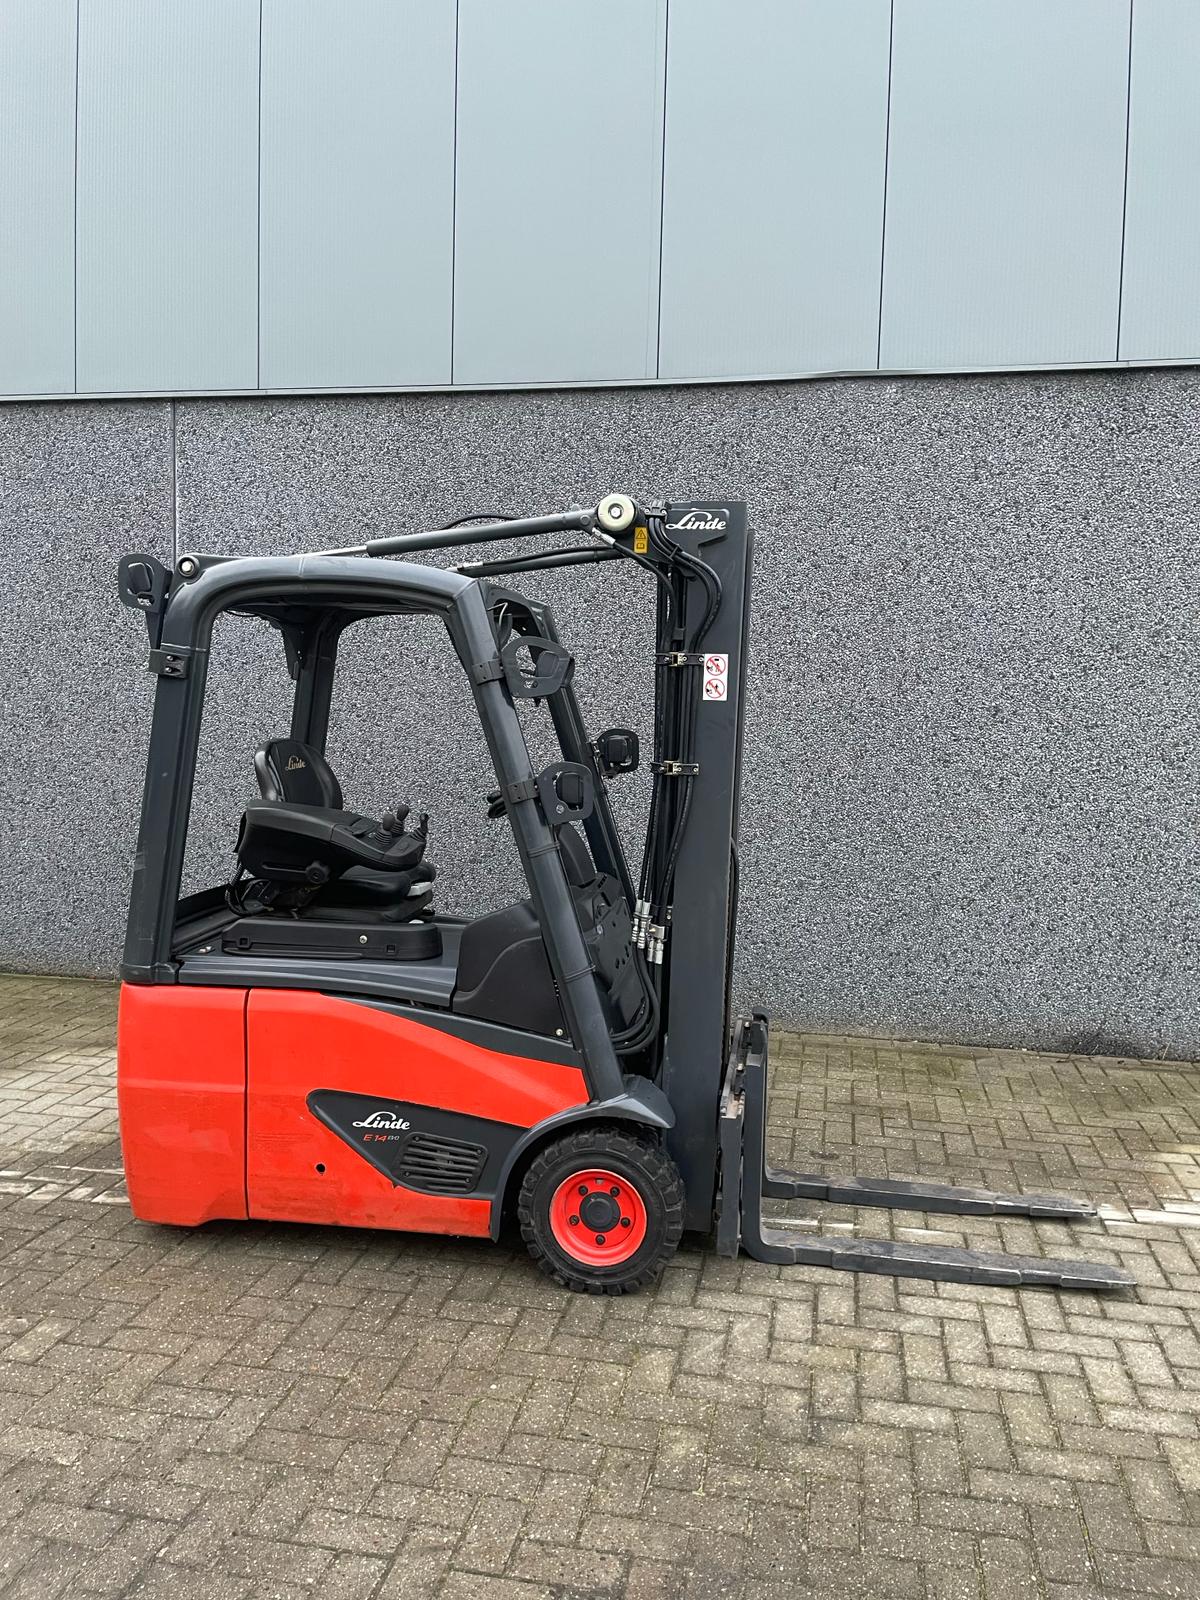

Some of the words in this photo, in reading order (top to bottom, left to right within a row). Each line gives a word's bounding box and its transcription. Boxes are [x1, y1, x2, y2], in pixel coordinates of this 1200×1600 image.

[665, 511, 727, 530] Linde
[285, 755, 306, 771] Linde
[352, 1111, 411, 1130] Linde
